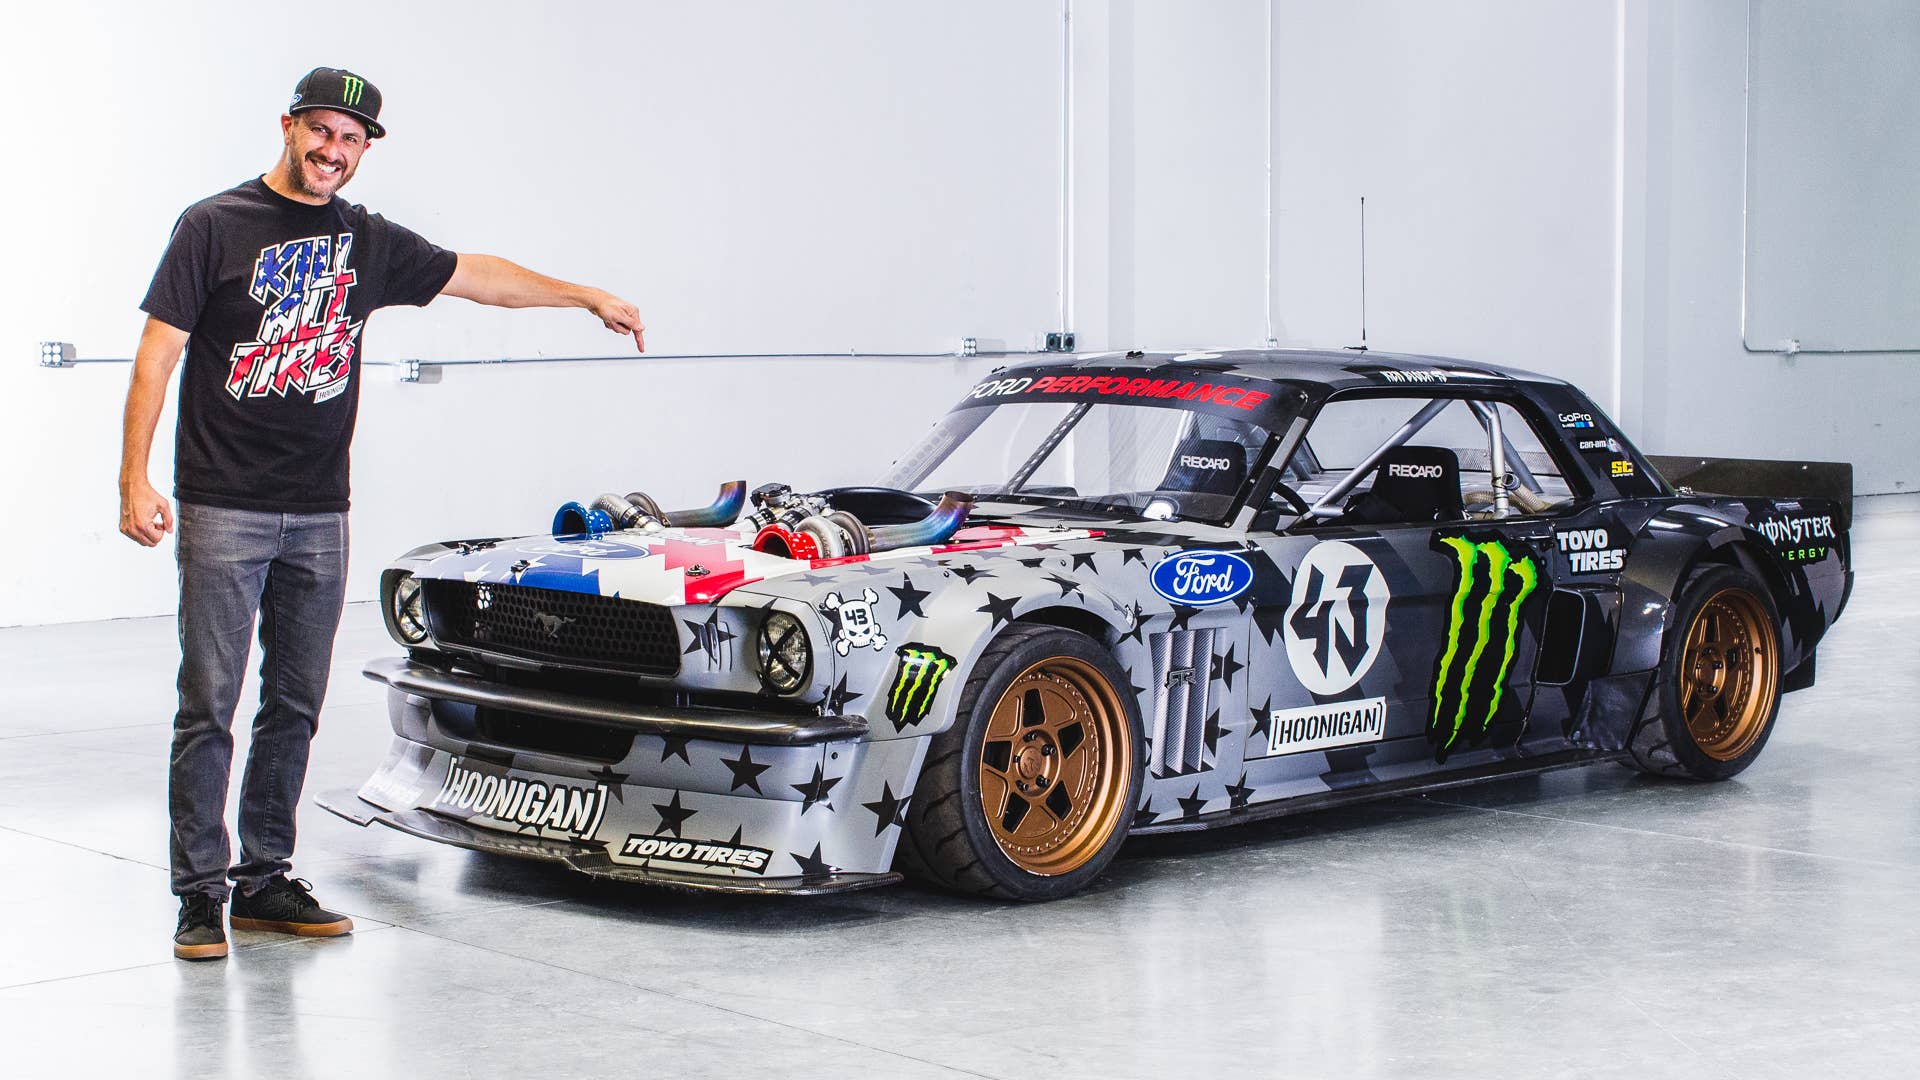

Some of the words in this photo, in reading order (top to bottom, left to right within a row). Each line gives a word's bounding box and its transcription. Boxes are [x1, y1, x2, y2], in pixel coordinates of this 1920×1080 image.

[249, 233, 357, 305] KILL
[256, 285, 352, 345] ALL
[225, 321, 363, 400] TIRES
[961, 377, 1032, 403] FORD
[1025, 376, 1271, 411] PERFORMANCE
[1558, 412, 1591, 422] GoPro
[1580, 440, 1606, 449] can-am
[1180, 455, 1230, 470] RECARO
[1389, 463, 1442, 478] RECARO
[1556, 528, 1608, 551] TOYO
[1570, 548, 1624, 572] TIRES
[1172, 557, 1235, 596] Ford
[844, 608, 868, 626] 43
[1290, 563, 1374, 679] 43
[625, 838, 692, 861] TOYO
[691, 844, 769, 869] TIRES
